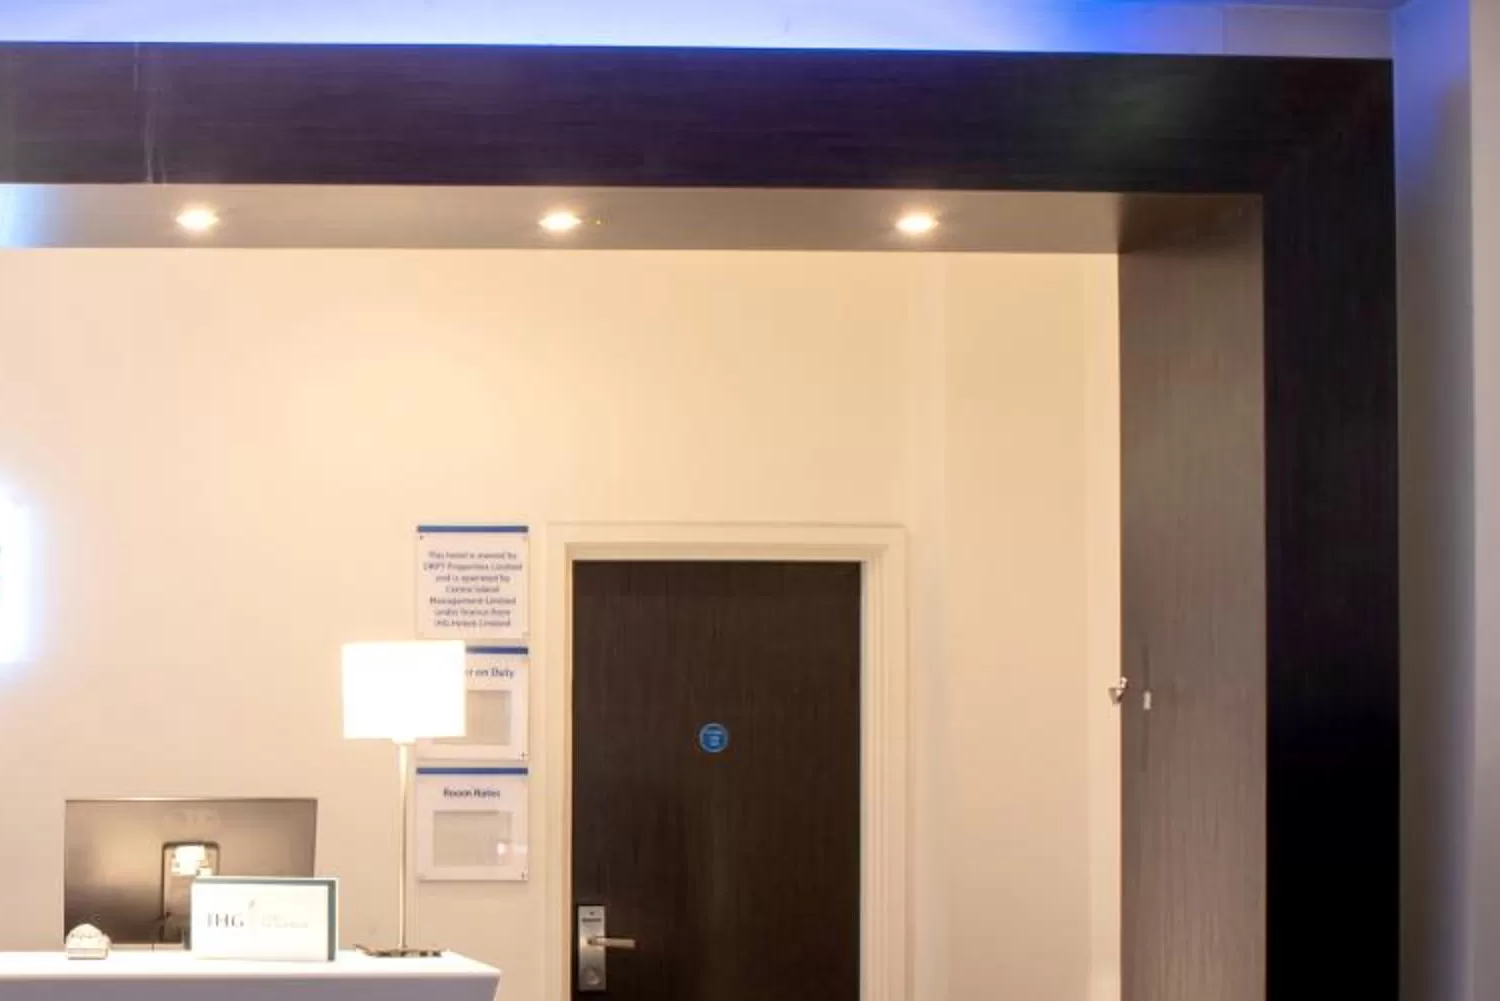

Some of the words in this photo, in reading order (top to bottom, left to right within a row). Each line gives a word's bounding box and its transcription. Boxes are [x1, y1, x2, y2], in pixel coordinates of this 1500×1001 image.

[475, 669, 489, 677] on
[491, 666, 515, 680] Duty
[443, 788, 472, 798] Room
[474, 788, 501, 798] Rates
[207, 912, 245, 929] IHG
